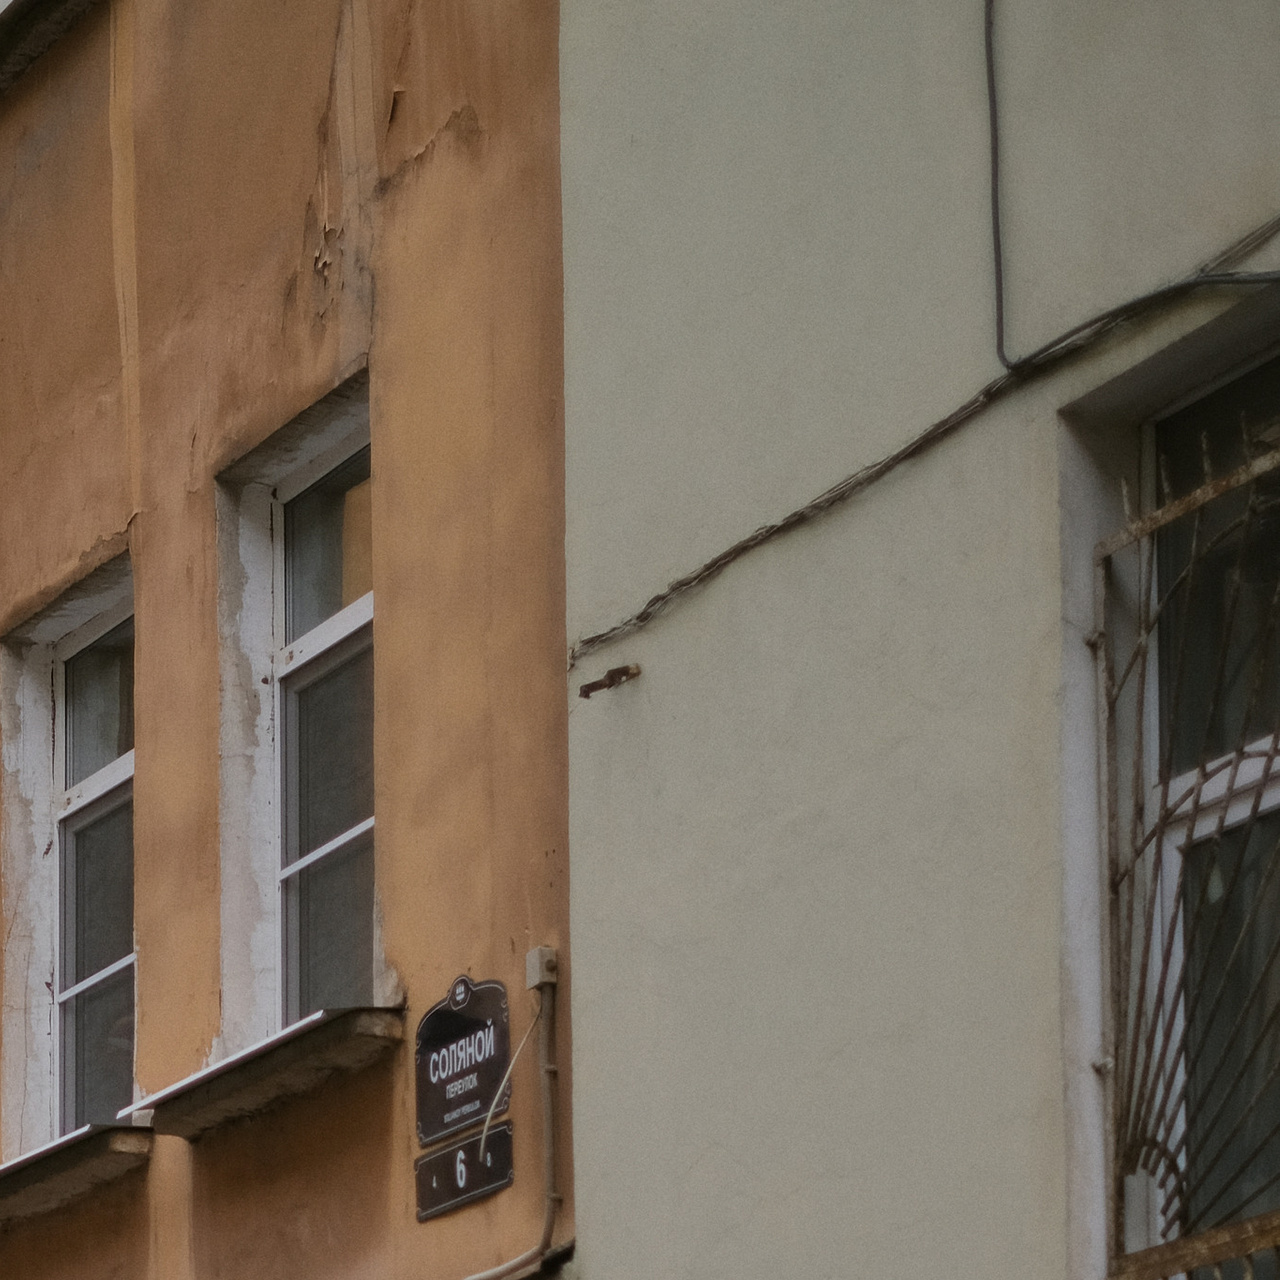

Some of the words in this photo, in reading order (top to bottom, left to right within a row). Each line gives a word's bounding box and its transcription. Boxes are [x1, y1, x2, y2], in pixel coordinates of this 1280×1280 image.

[430, 1018, 494, 1084] СОЛЯНОЙ
[456, 1150, 466, 1189] 6
[486, 1152, 492, 1168] 8
